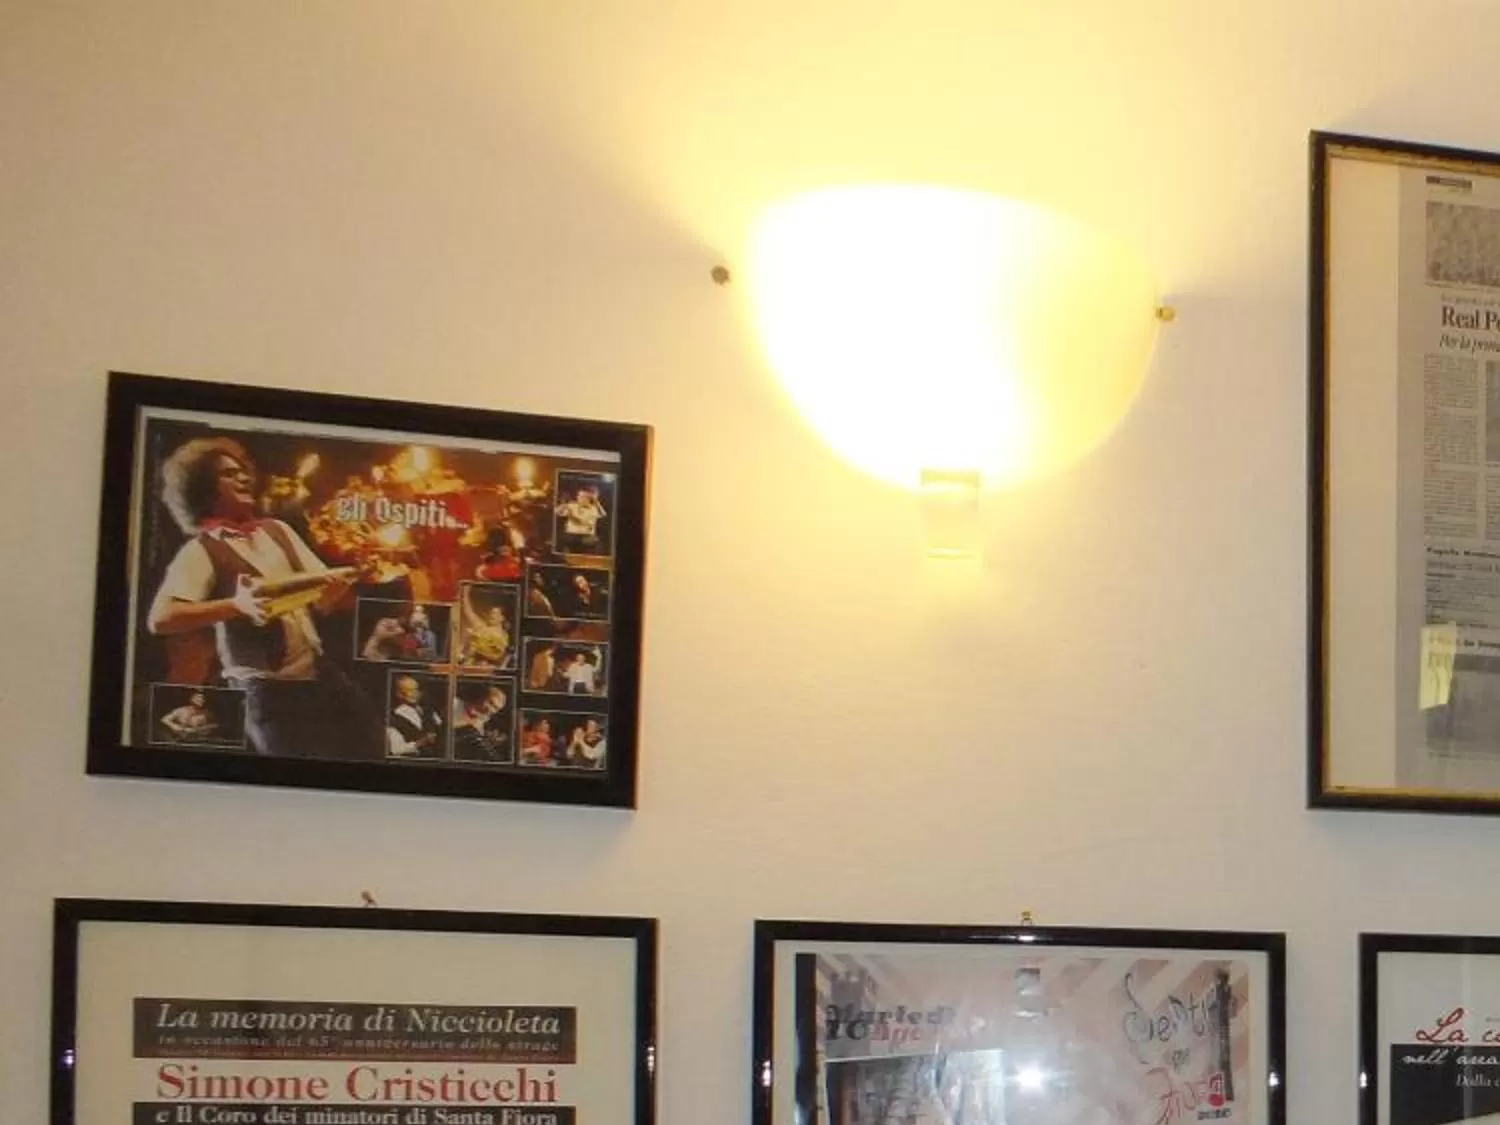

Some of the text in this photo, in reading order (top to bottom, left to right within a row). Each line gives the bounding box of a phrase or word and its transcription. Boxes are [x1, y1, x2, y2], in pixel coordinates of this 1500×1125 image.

[1441, 304, 1480, 330] Real
[157, 1003, 561, 1034] La memoria di Niccioleta
[1415, 1007, 1469, 1044] La
[157, 1063, 556, 1103] Simone Cristicchi
[200, 1106, 257, 1125] Coro
[263, 1106, 297, 1125] dei
[304, 1107, 400, 1125] minatori
[405, 1107, 427, 1125] di
